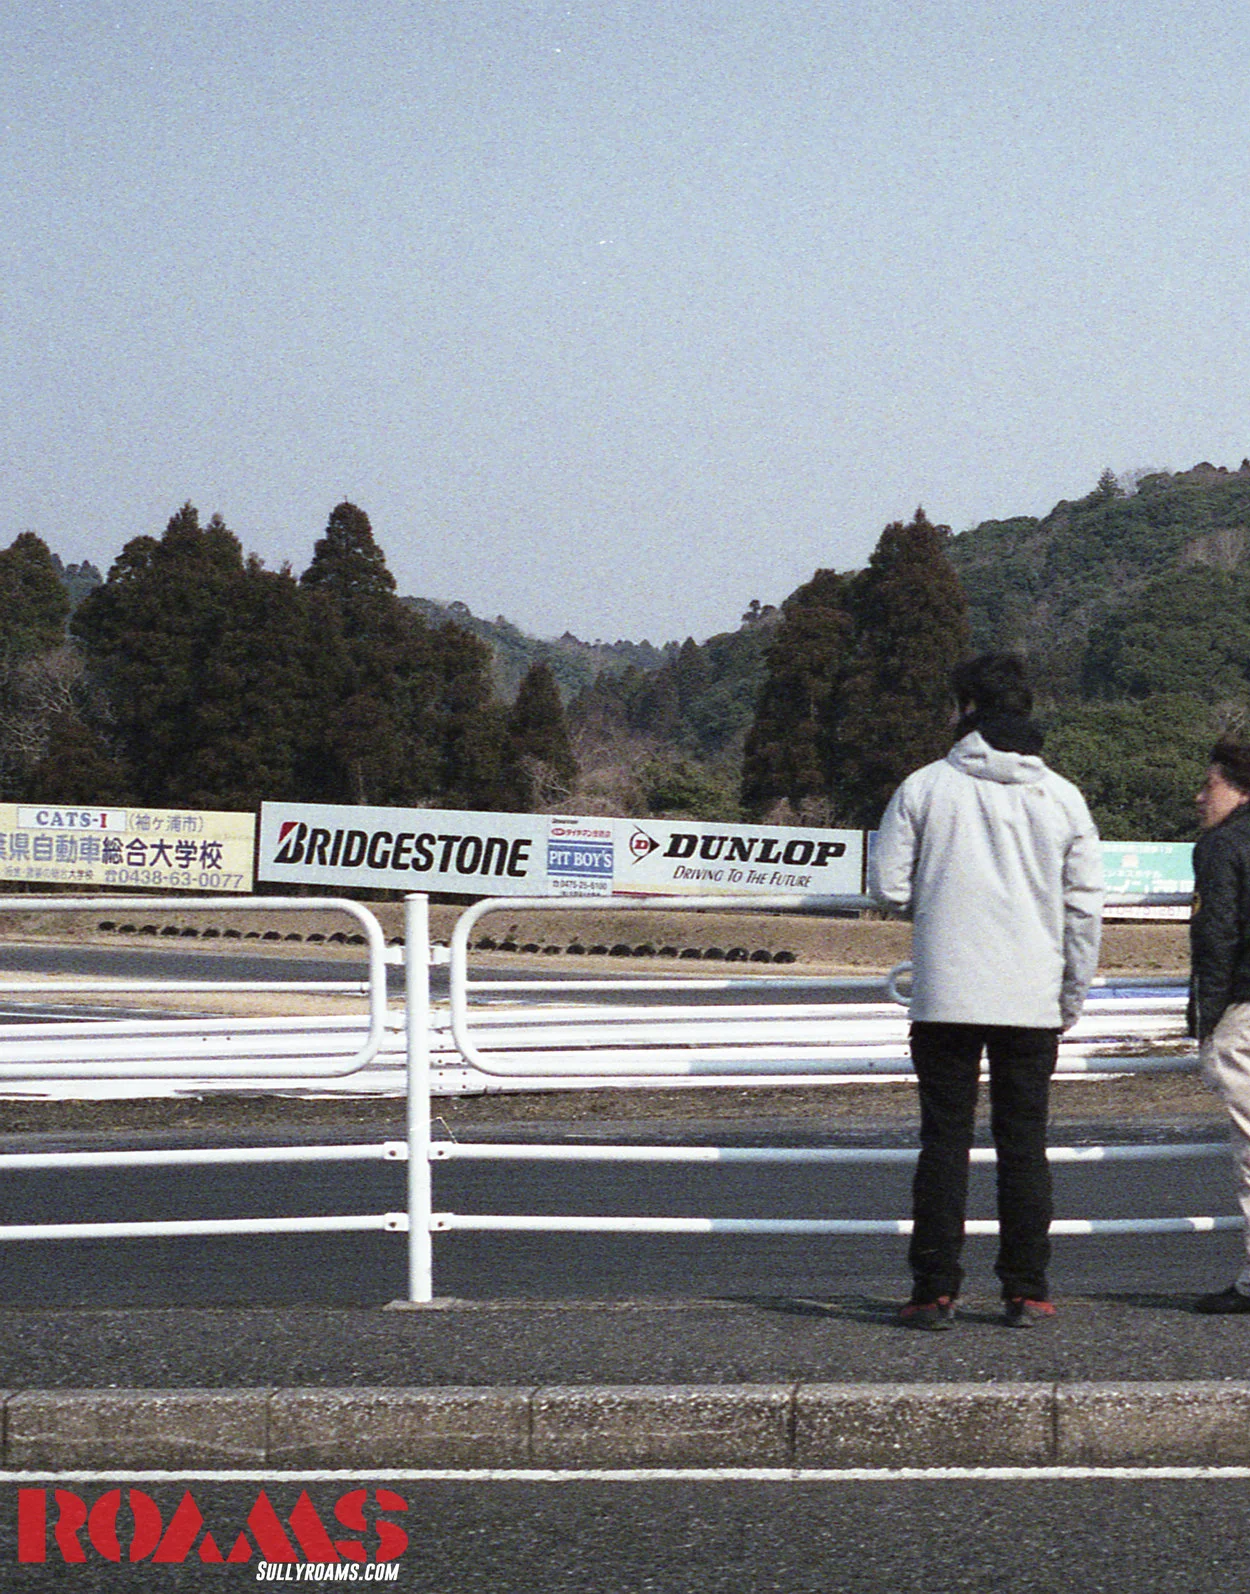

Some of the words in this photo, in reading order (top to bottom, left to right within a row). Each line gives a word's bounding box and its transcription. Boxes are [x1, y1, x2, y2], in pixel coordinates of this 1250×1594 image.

[36, 810, 107, 828] CATS-I
[273, 821, 532, 877] BRIDGESTONE
[549, 851, 571, 865] PIT
[574, 849, 612, 868] BOY'S
[663, 833, 846, 867] DUNLOP
